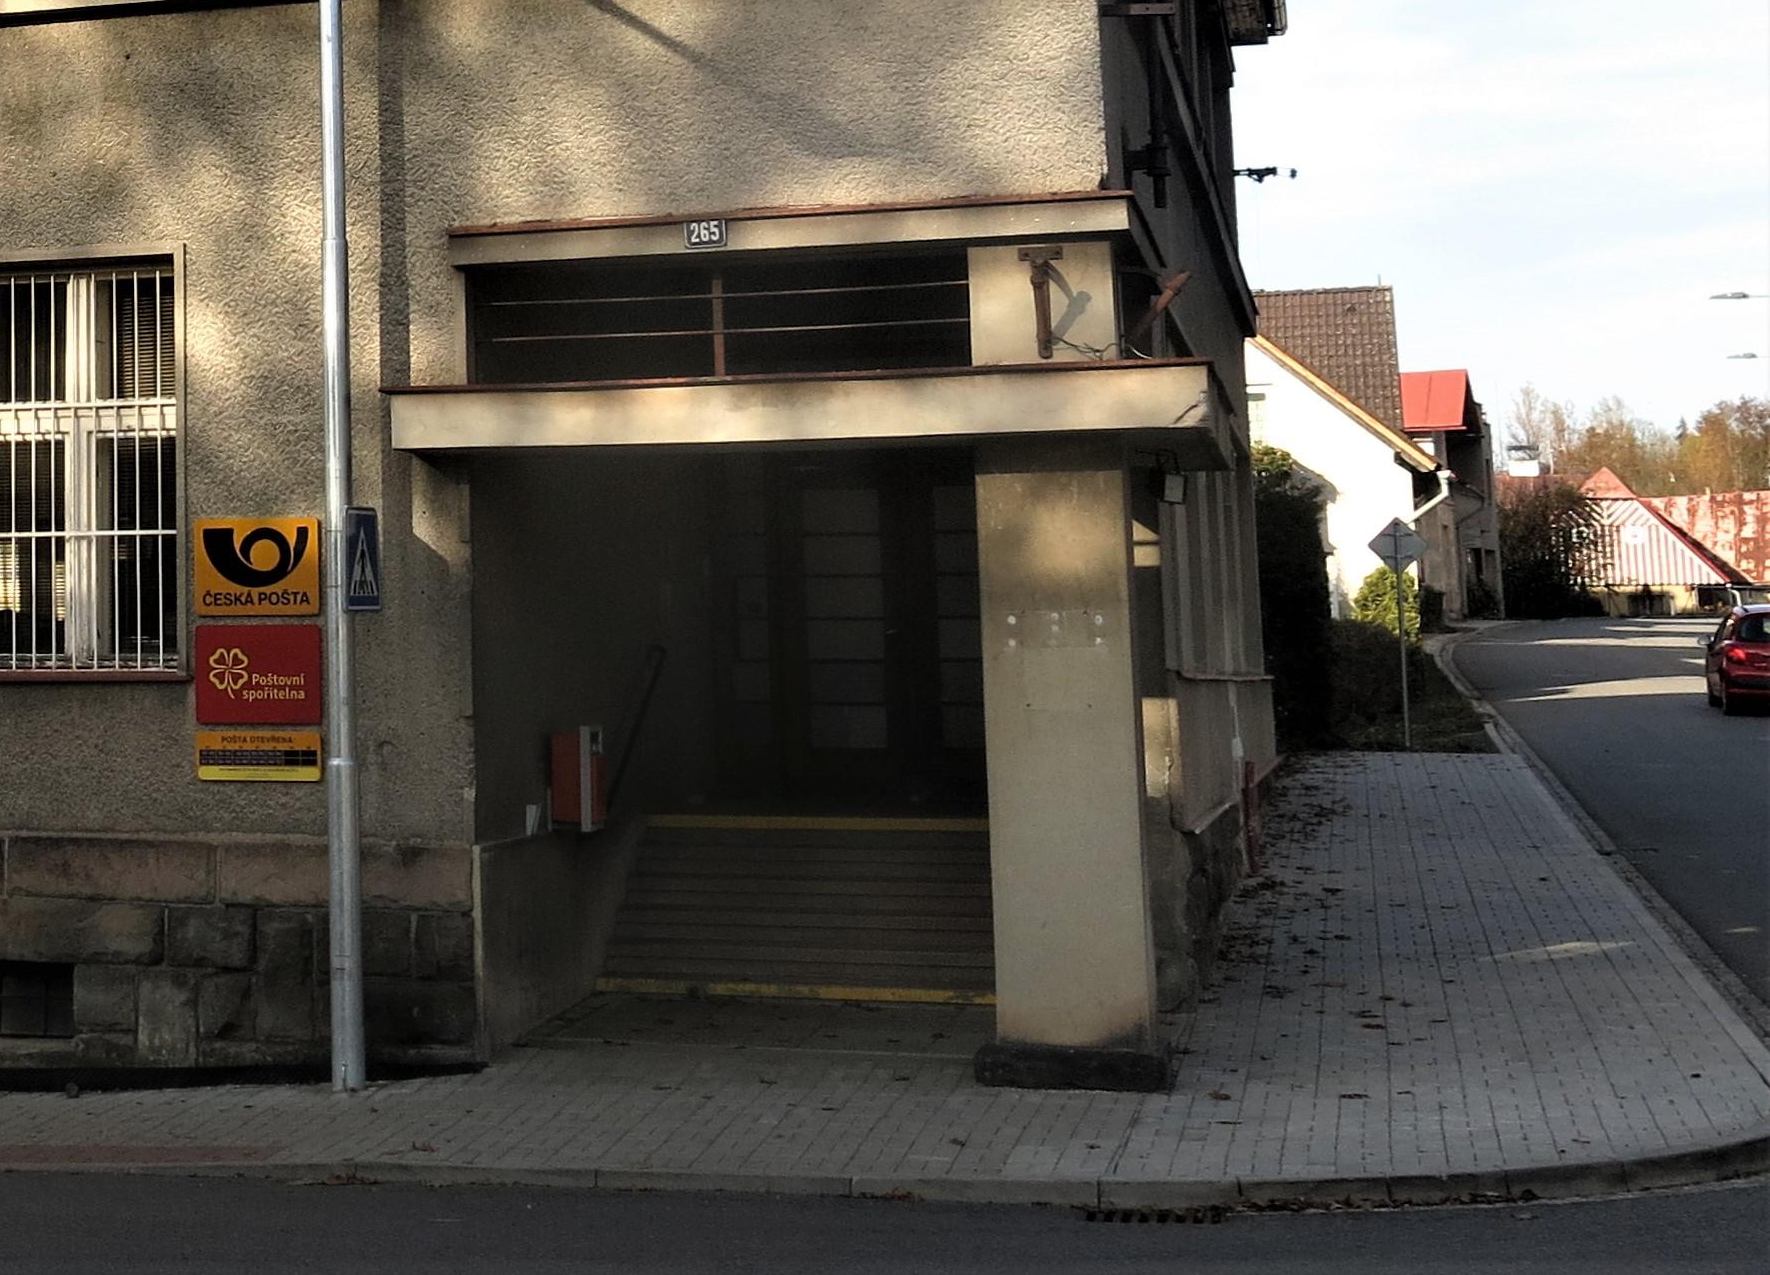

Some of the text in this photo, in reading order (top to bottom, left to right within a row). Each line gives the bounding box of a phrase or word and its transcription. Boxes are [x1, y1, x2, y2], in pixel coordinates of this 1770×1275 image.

[690, 220, 720, 243] 265
[202, 589, 310, 606] ČESKÁ POŠTA
[252, 673, 304, 685] Poštovní
[242, 686, 305, 703] spořitelna
[221, 735, 248, 744] POŠTA
